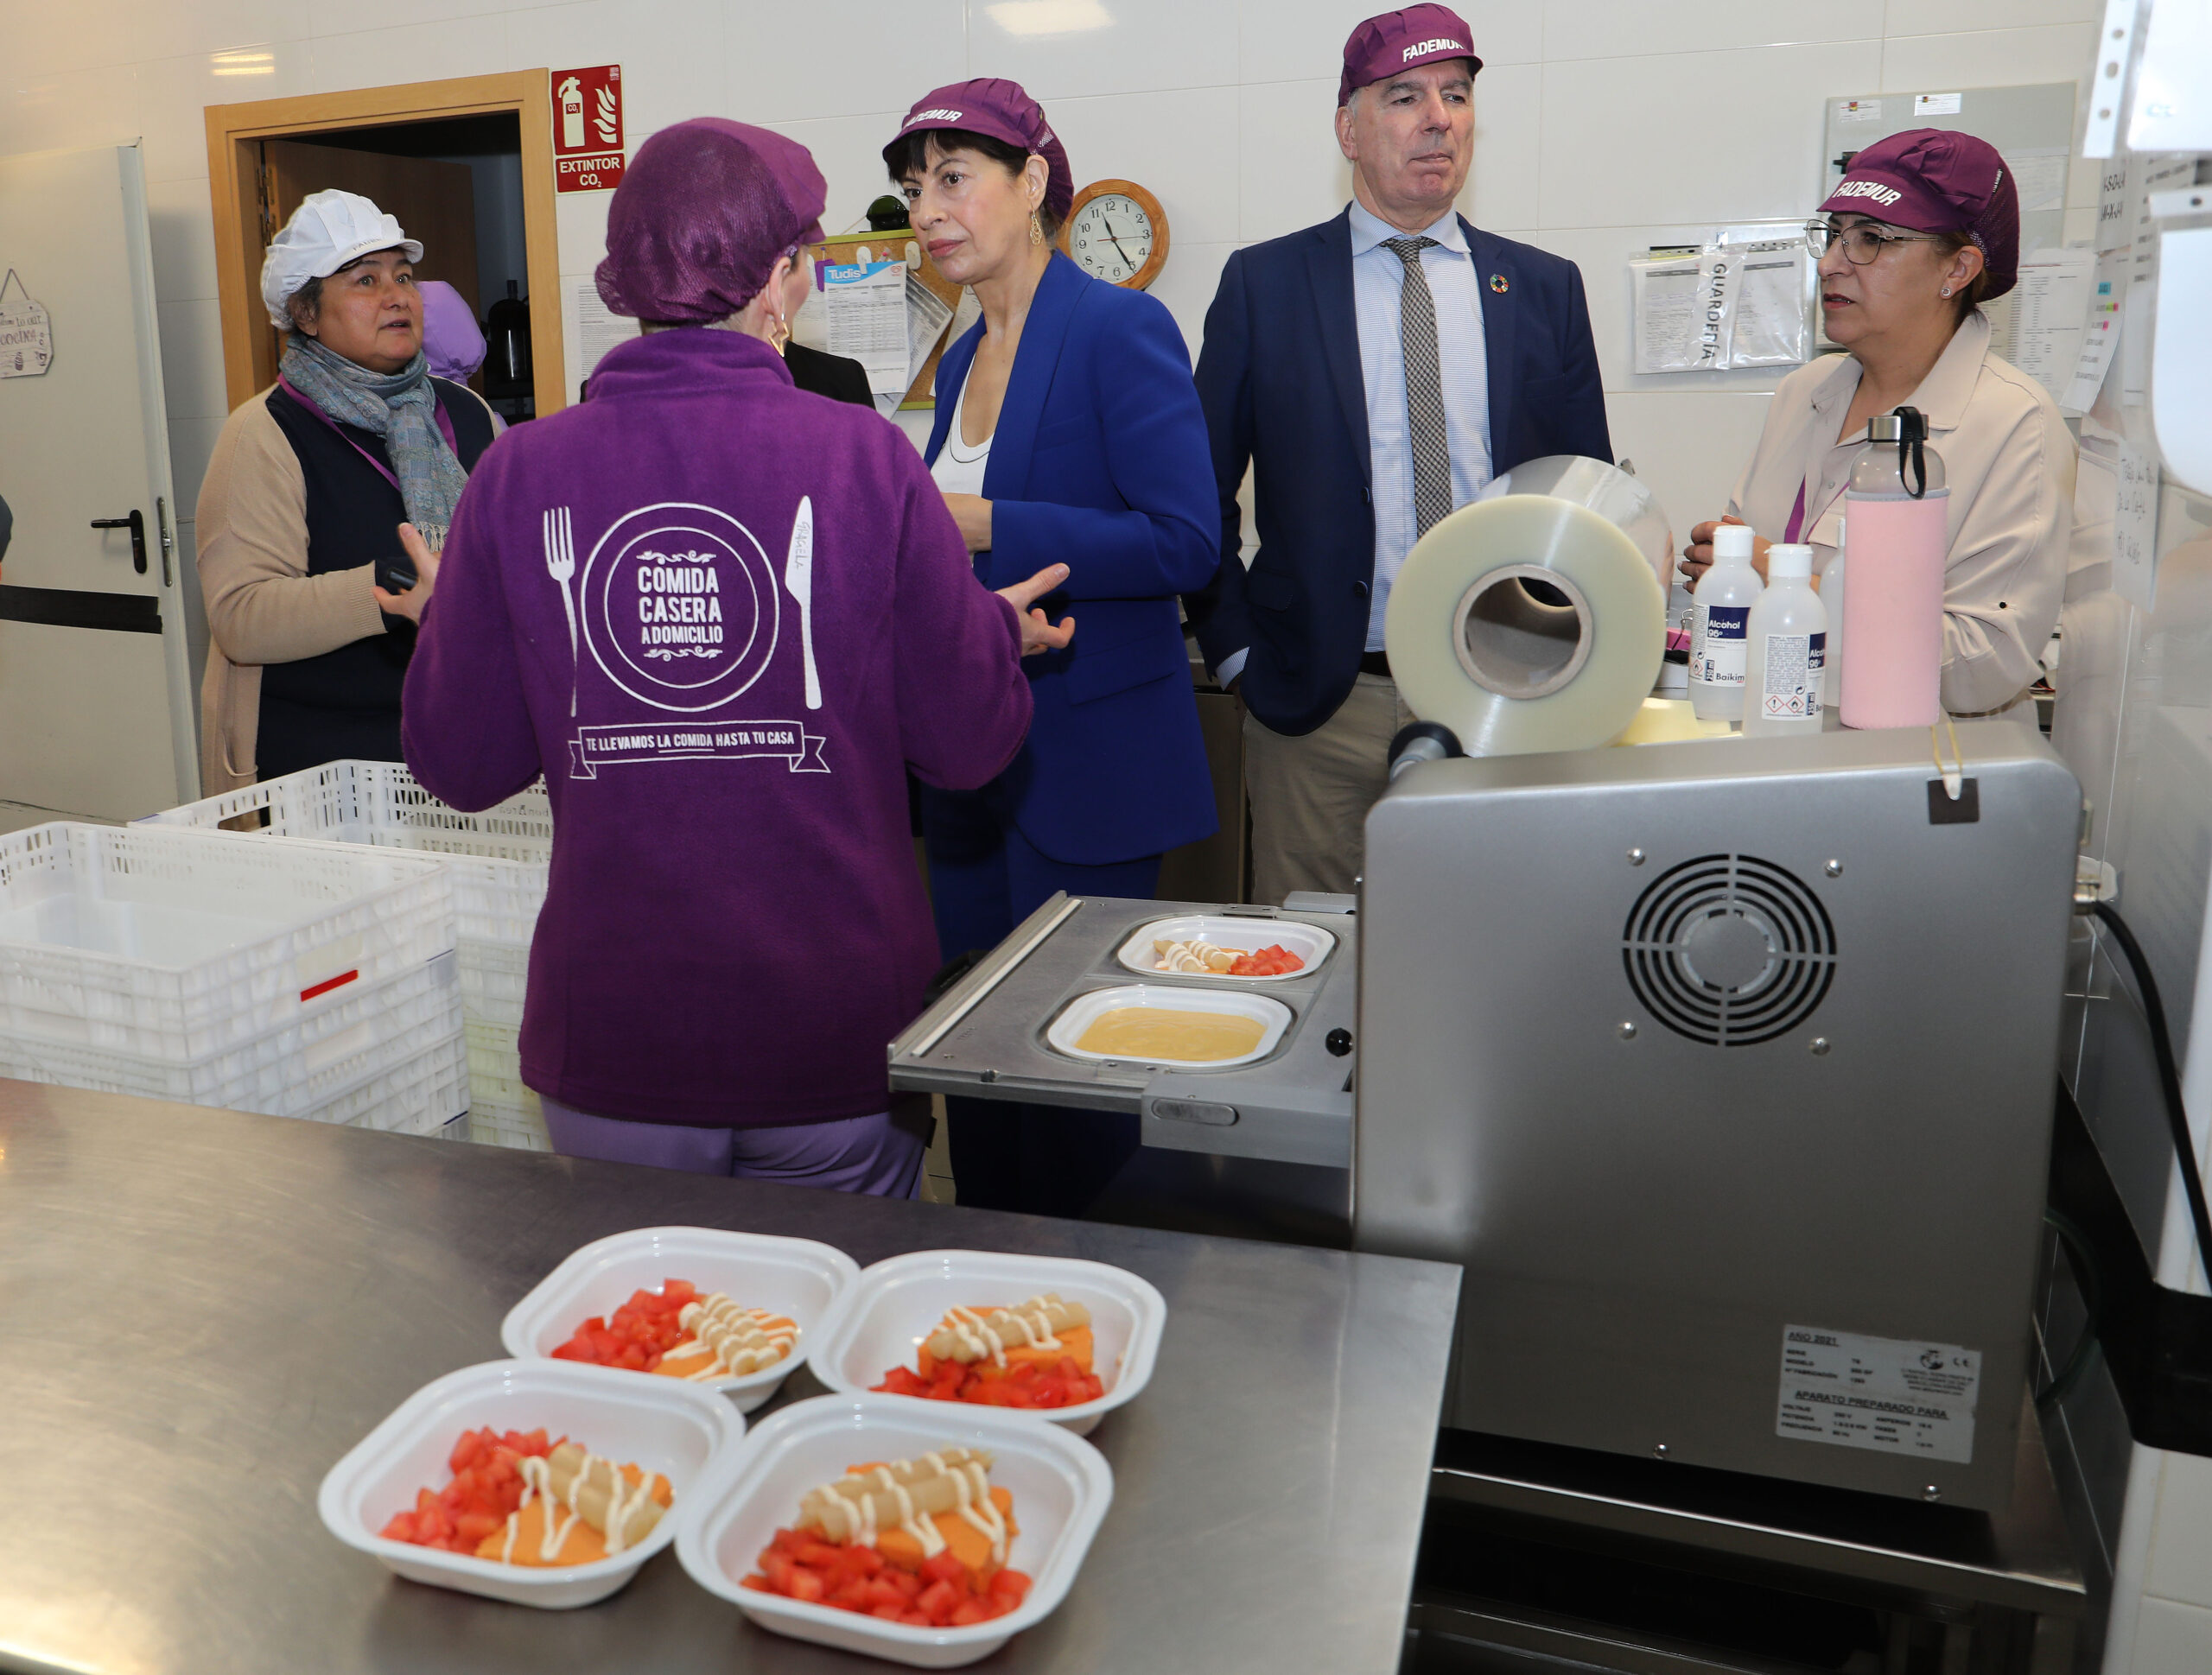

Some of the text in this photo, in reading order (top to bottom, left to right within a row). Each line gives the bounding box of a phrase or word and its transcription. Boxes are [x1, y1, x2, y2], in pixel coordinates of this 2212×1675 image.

[560, 156, 620, 174] EXTINTOR
[580, 174, 602, 187] CO2
[1832, 181, 1901, 206] FADEMUR
[1105, 201, 1116, 212] 12
[1125, 203, 1128, 213] 1
[1091, 208, 1099, 219] 11
[1135, 213, 1144, 224] 2
[1081, 223, 1090, 233] 10
[1142, 229, 1150, 239] 3
[1078, 239, 1087, 249] 9
[1139, 247, 1146, 256] 4
[1085, 256, 1093, 265] 8
[1128, 261, 1136, 270] 5
[828, 268, 861, 279] Tudis
[1097, 265, 1104, 276] 7
[1113, 267, 1121, 276] 6
[638, 566, 720, 593] COMIDA
[639, 596, 722, 623] CASERA
[1708, 619, 1740, 629] Alcohol
[652, 625, 723, 644] DOMICILIO
[586, 731, 795, 751] TE LLEVAMOS LA COMIDA HASTA TU CASA
[1795, 1390, 1947, 1418] APARATO PREPARADO PARA
